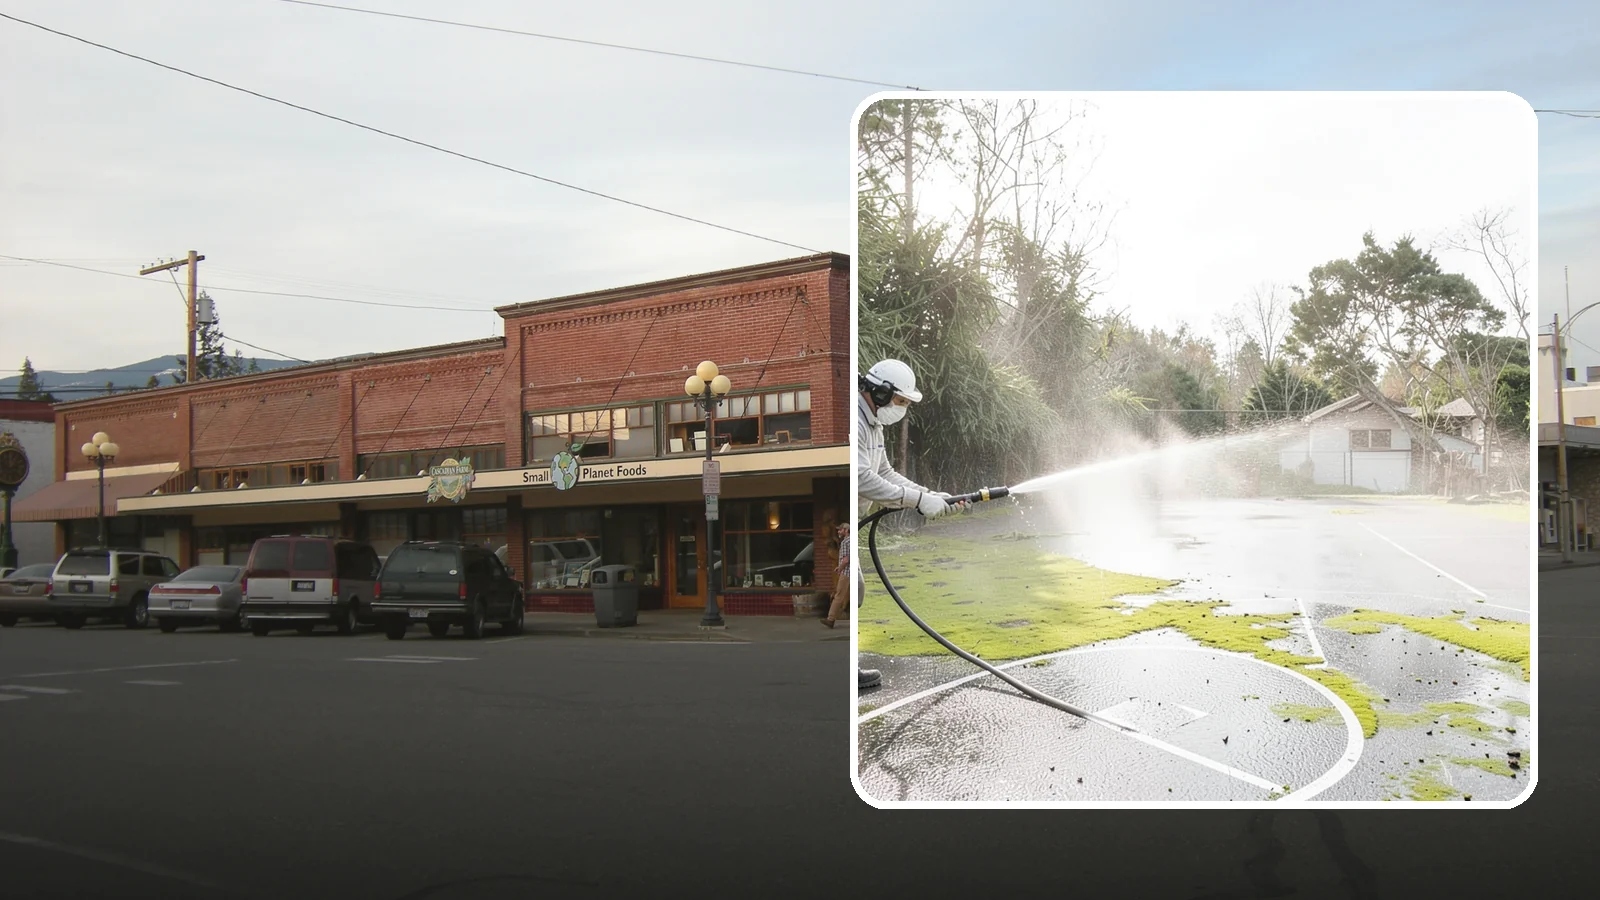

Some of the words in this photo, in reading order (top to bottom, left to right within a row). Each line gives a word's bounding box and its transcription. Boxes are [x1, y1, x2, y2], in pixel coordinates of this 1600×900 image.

[431, 467, 455, 476] CASCADIAN
[455, 466, 469, 474] FARM
[522, 471, 549, 483] Small
[582, 467, 614, 479] Planet
[616, 464, 647, 477] Foods
